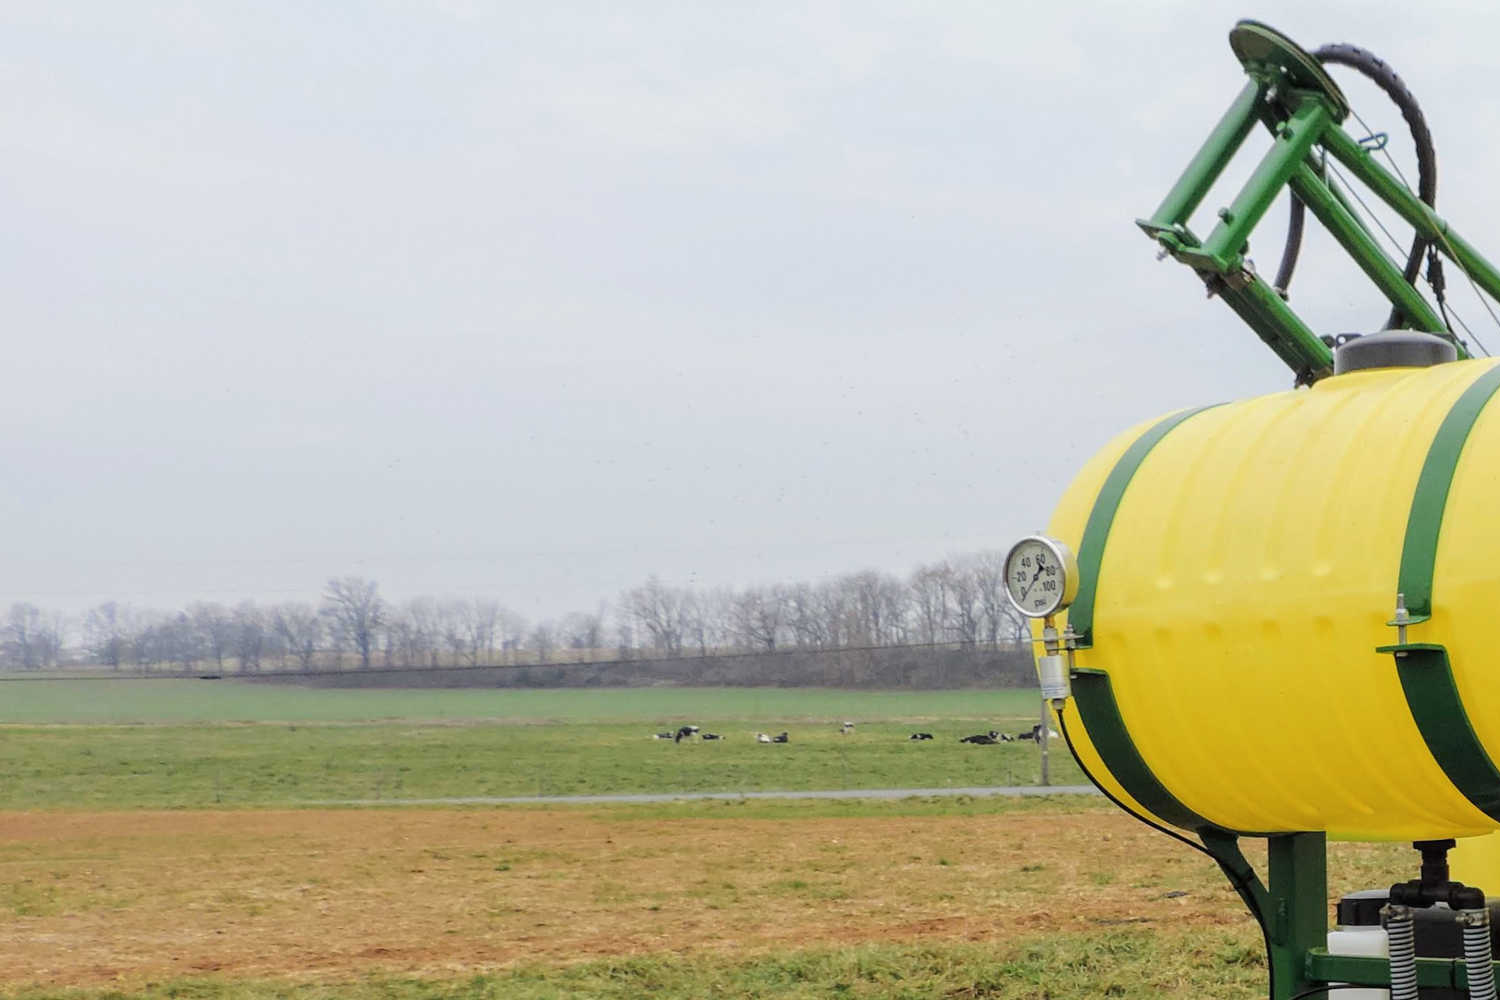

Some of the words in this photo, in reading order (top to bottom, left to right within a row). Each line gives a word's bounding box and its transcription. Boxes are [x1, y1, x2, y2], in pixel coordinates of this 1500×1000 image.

[1021, 557, 1031, 568] 40
[1035, 554, 1046, 565] 60
[1017, 571, 1026, 582] 20
[1043, 580, 1056, 591] 100
